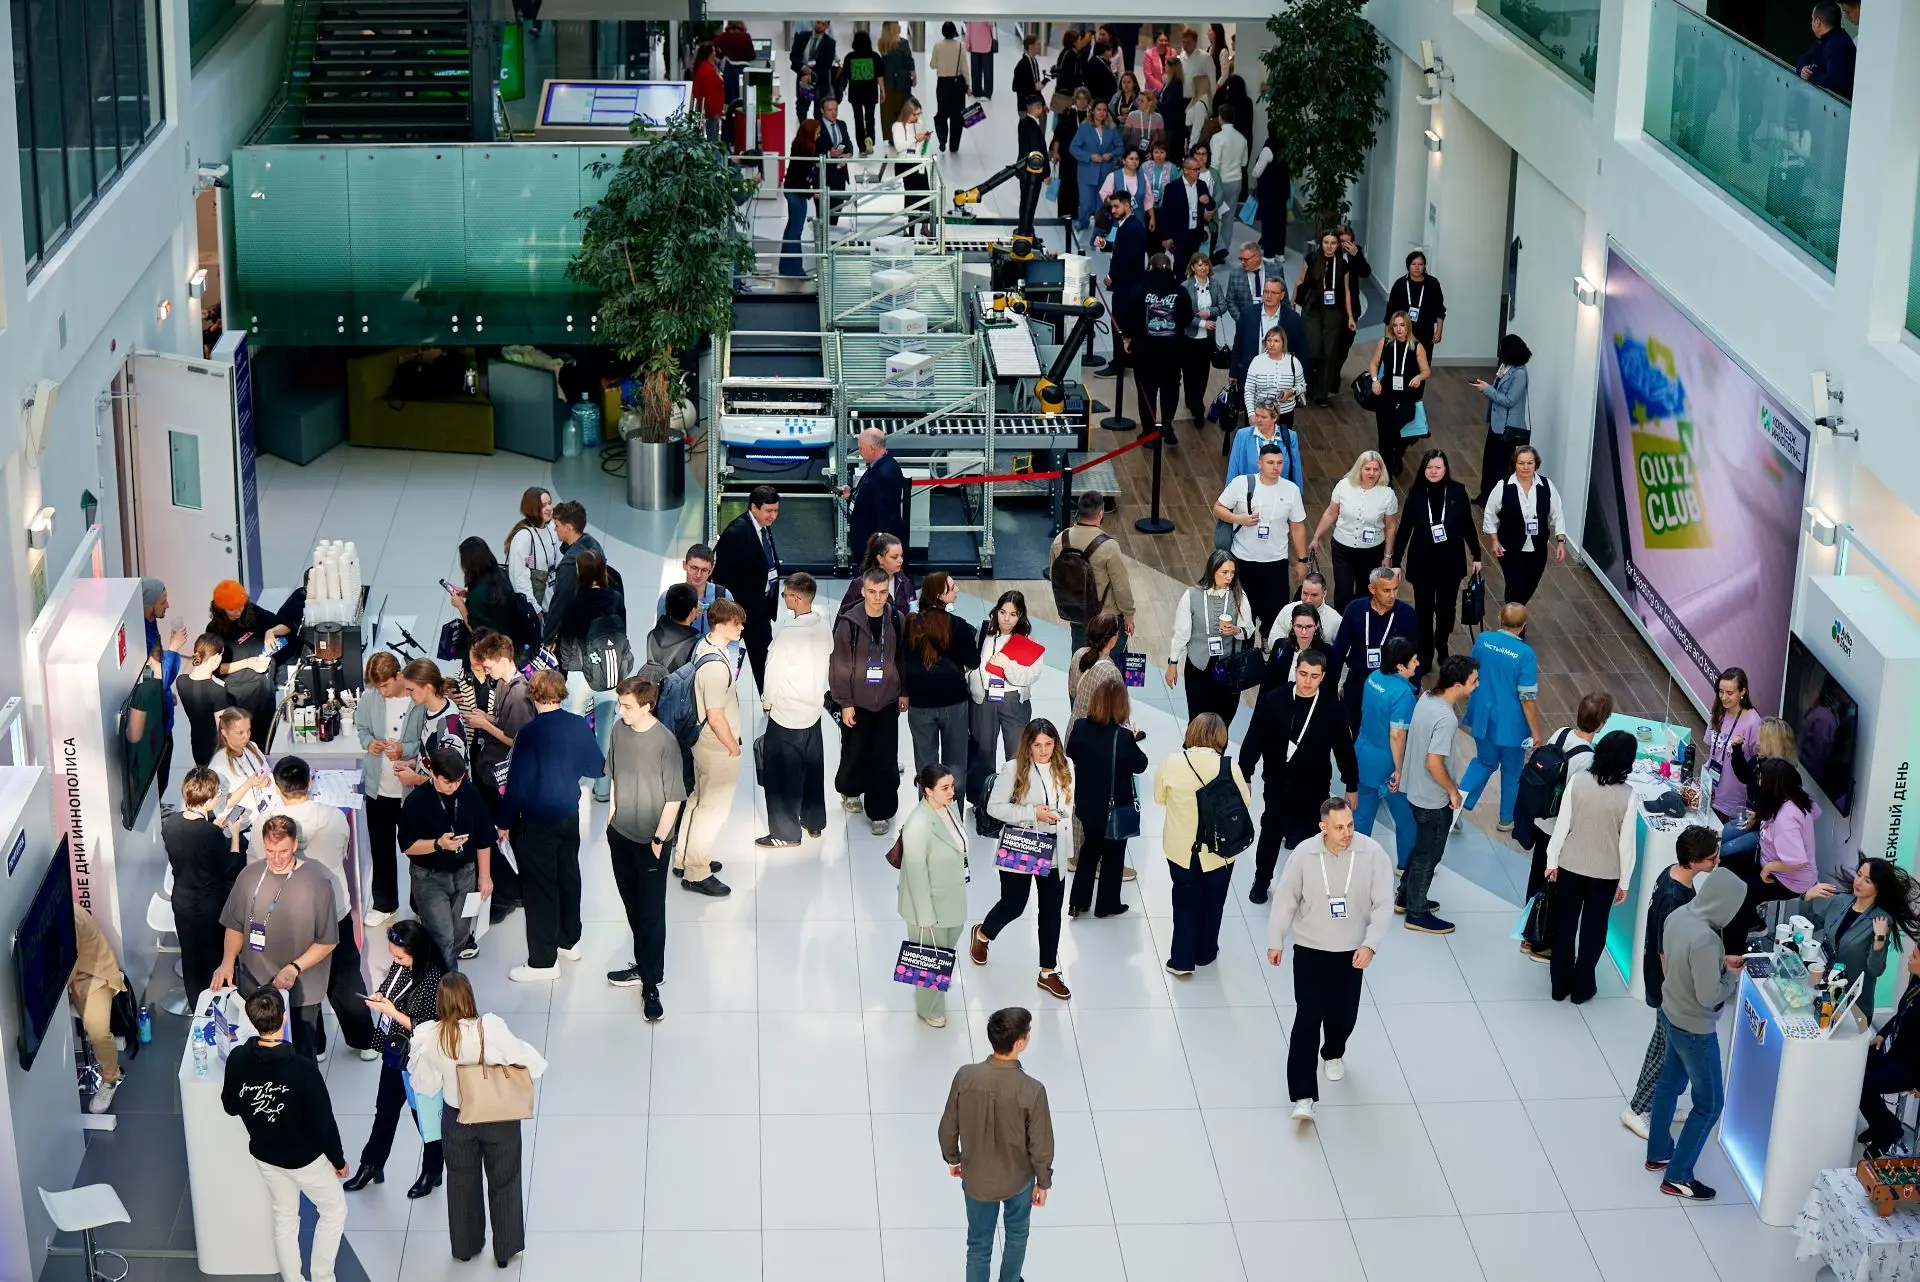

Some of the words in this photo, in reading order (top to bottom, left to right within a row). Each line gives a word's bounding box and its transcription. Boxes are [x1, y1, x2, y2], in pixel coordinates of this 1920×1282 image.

[1640, 454, 1695, 487] QUIZ
[1647, 487, 1702, 530] CLUB
[1625, 559, 1634, 577] for
[1633, 568, 1655, 607] boosting
[1654, 600, 1664, 616] our
[1663, 607, 1693, 652] knowledge
[1692, 647, 1704, 667] and
[63, 737, 85, 840] ИННОПОЛИСА
[1893, 761, 1909, 801] ДЕНЬ
[1002, 839, 1042, 854] ИННОПОЛИСА
[1004, 833, 1038, 847] ЦИФРОВЫЕ
[1038, 841, 1053, 850] ДНИ
[73, 845, 90, 876] ДНИ
[901, 956, 941, 970] ИННОПОЛИСА
[903, 950, 938, 964] ЦИФРОВЫЕ
[938, 959, 952, 968] ДНИ
